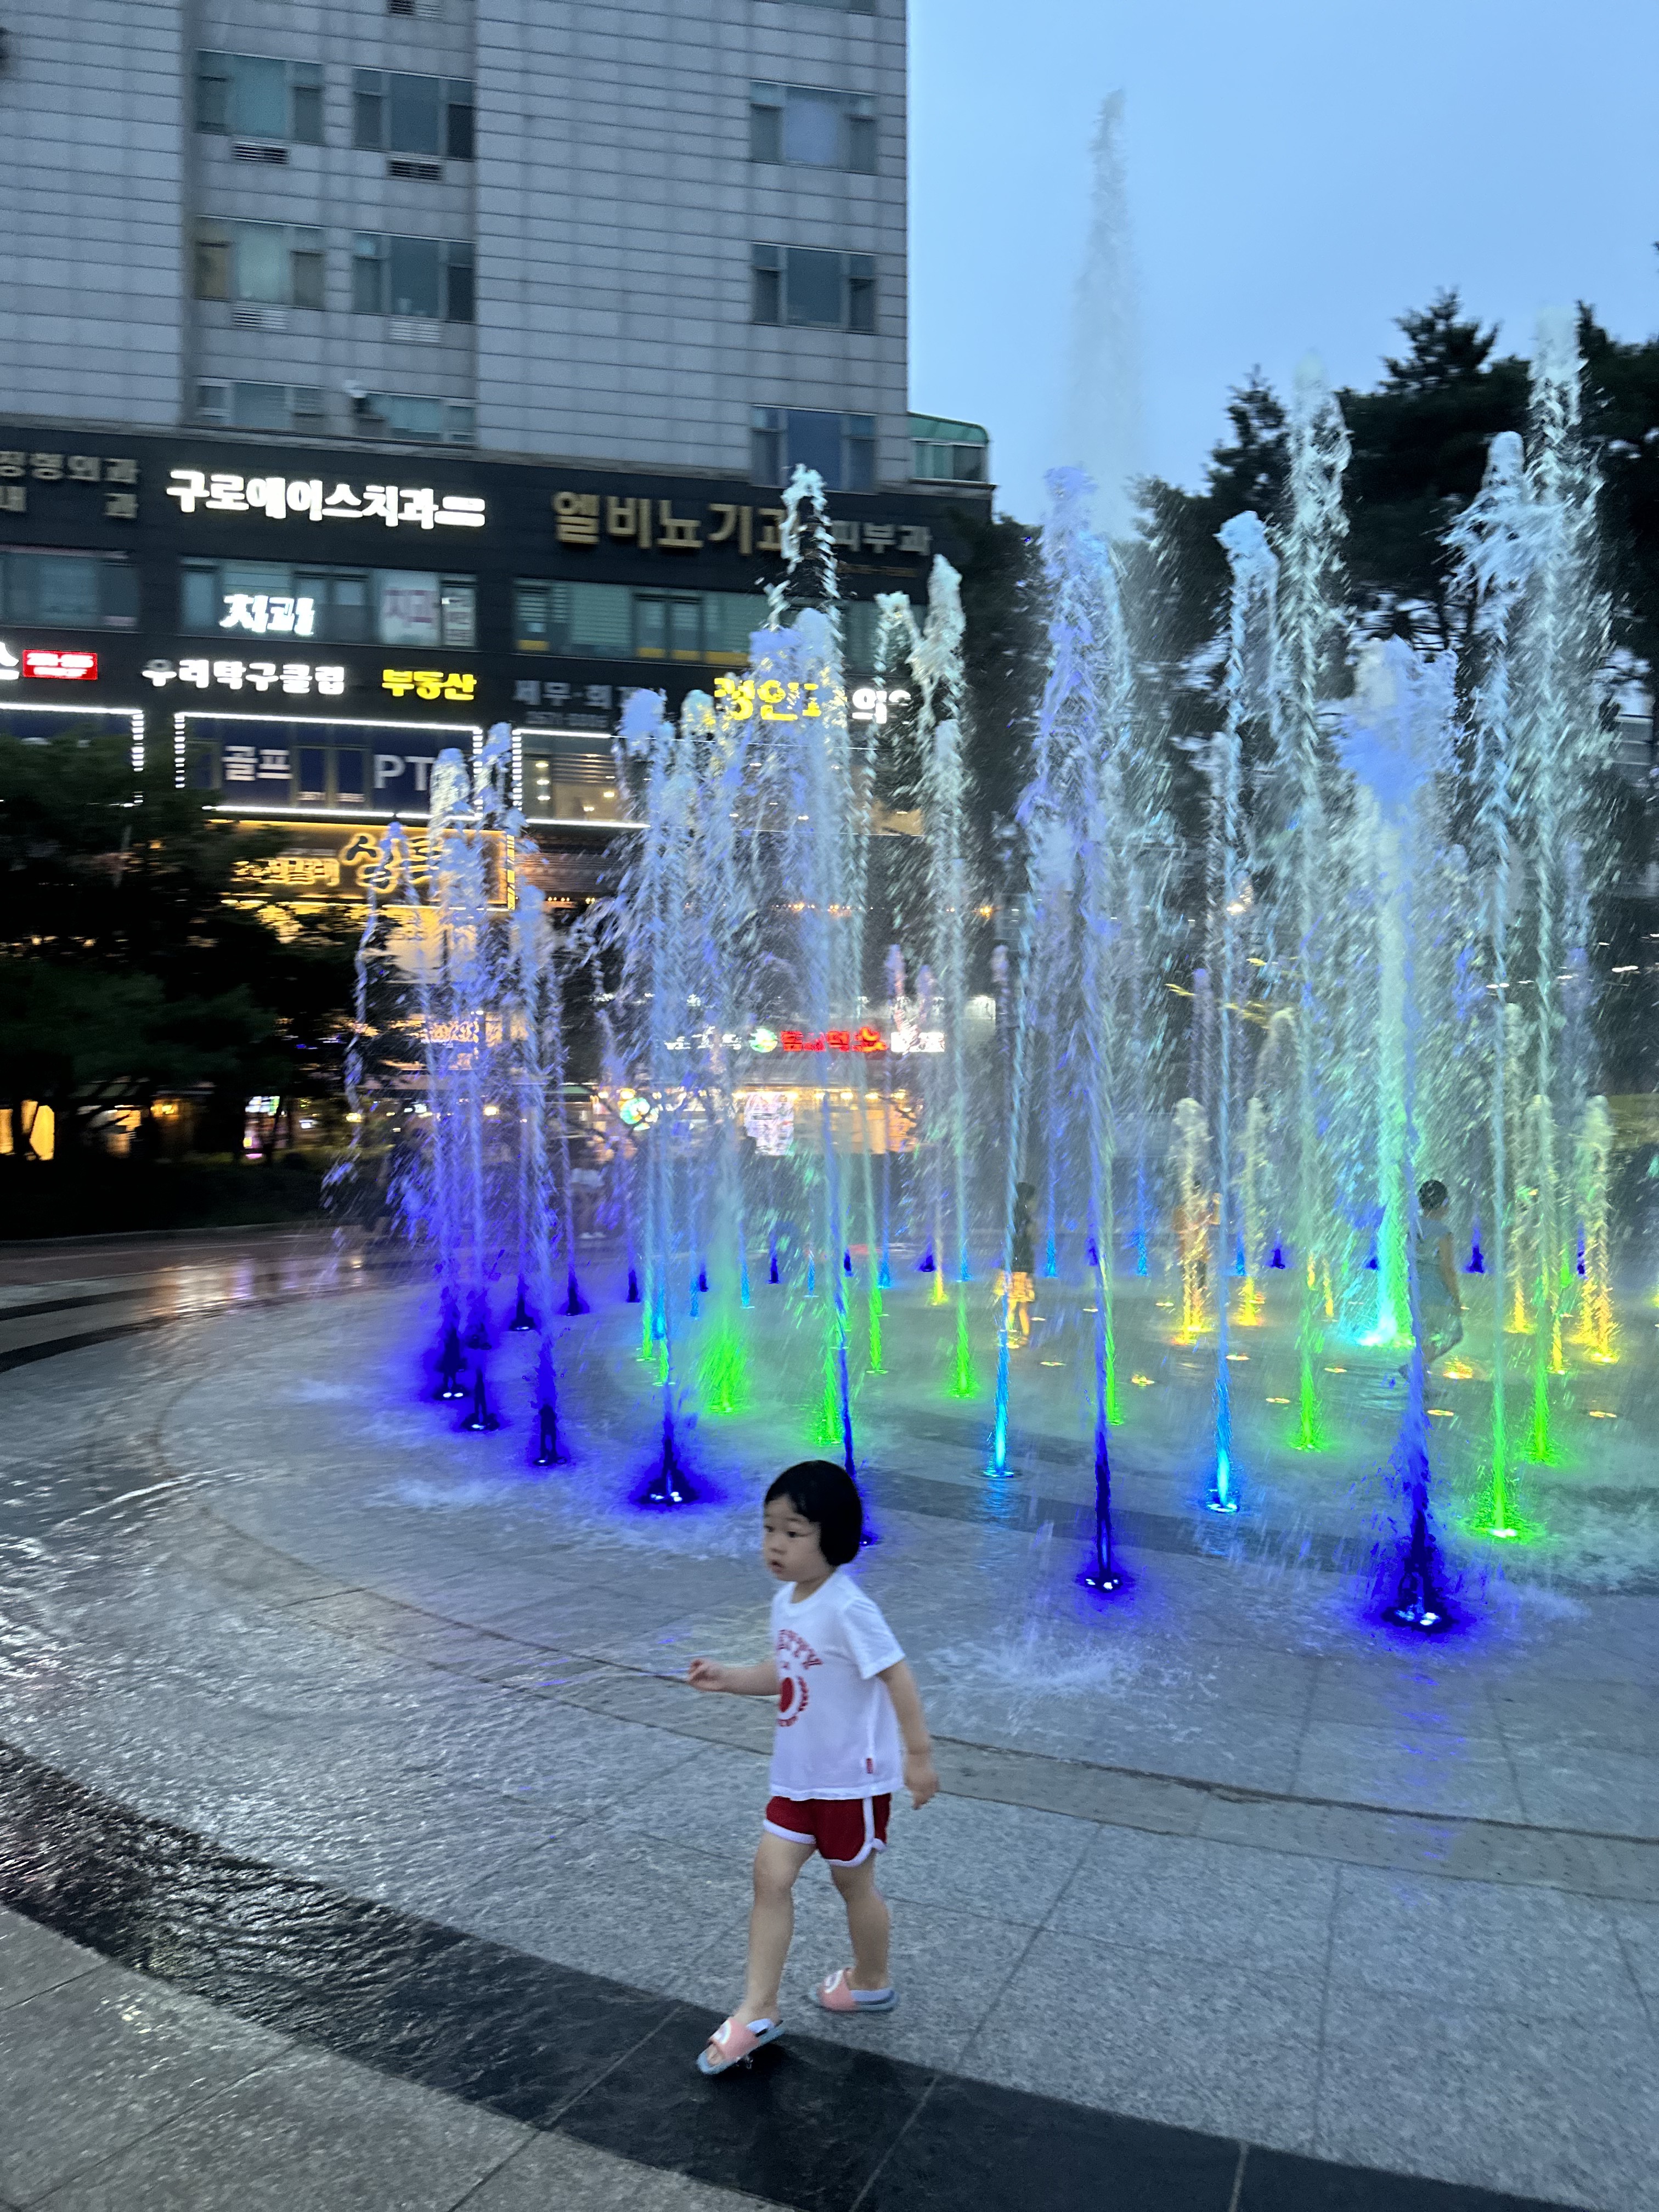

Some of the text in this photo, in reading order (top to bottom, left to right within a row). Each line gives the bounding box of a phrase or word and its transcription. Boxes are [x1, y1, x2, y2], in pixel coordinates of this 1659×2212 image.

[167, 470, 439, 529] 구로에이스치과
[142, 659, 345, 695] 우리탁구클럽
[382, 669, 477, 701] 부동산
[221, 746, 293, 781] 골프
[374, 754, 437, 791] PT
